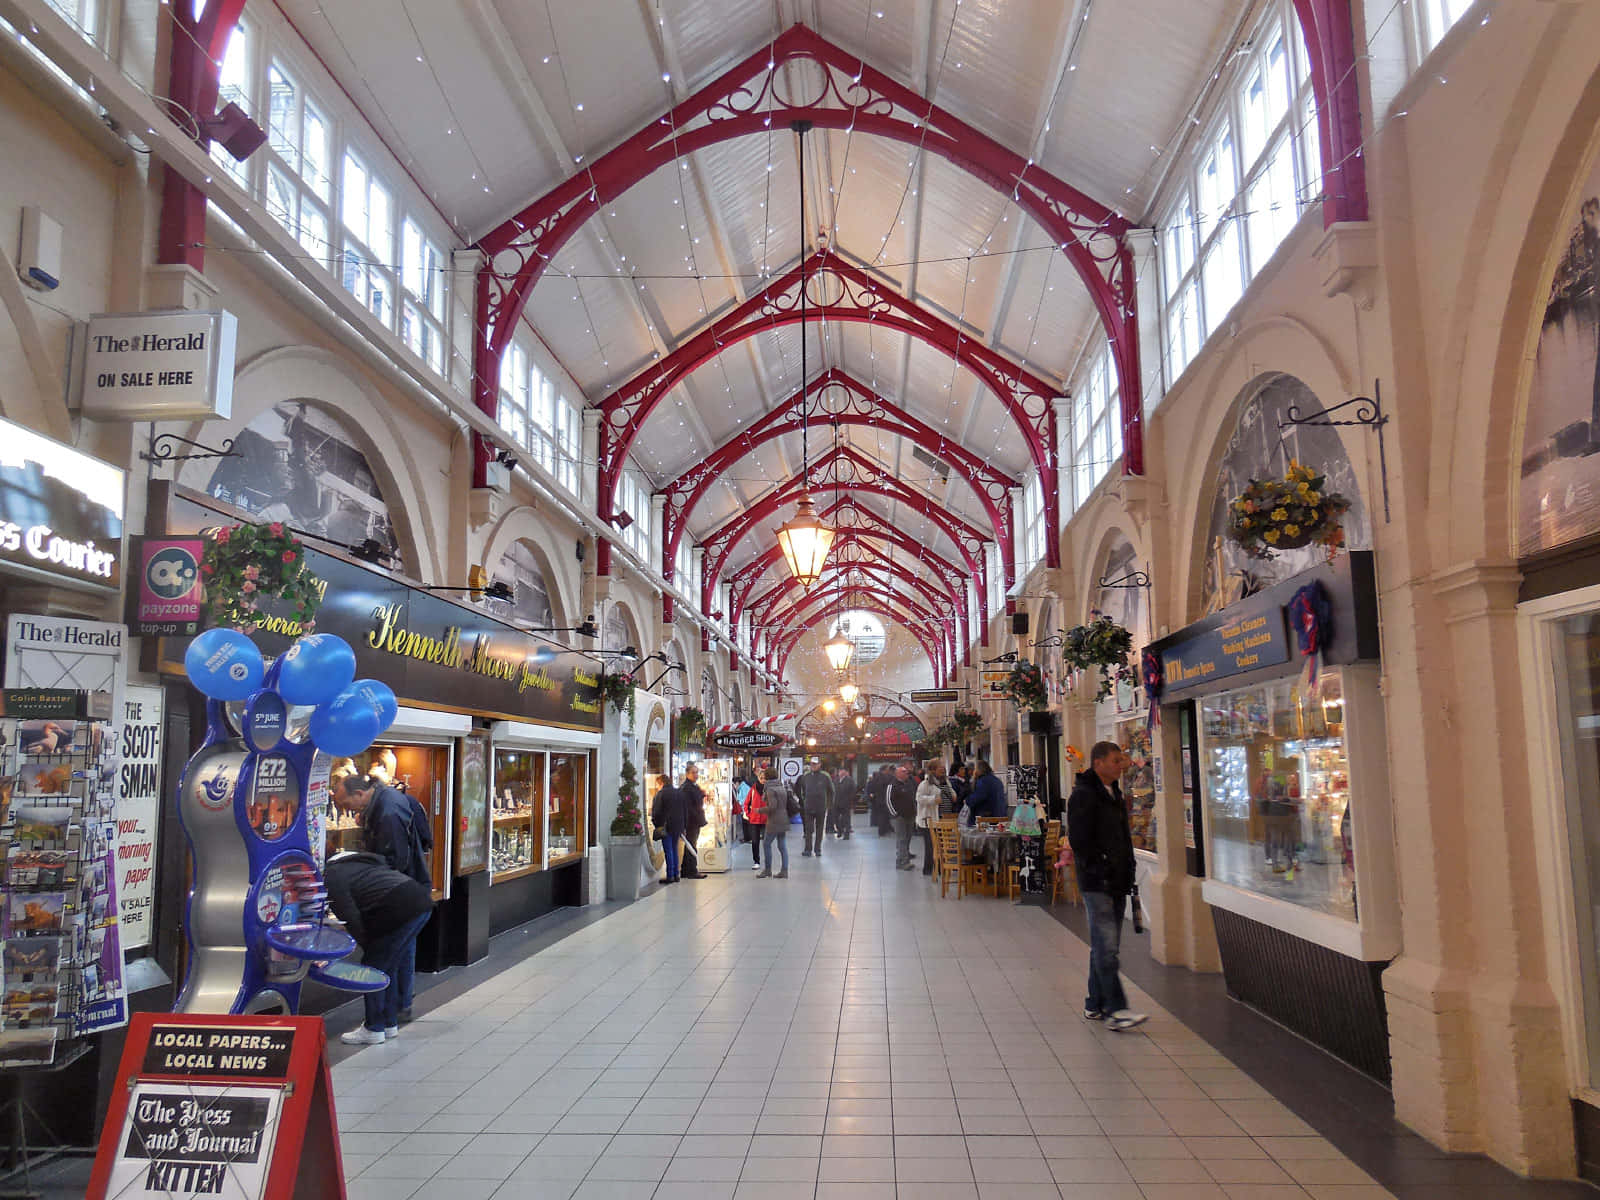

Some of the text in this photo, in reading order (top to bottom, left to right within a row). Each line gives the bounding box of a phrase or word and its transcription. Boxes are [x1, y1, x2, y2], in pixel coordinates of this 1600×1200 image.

[94, 333, 205, 352] The Herald
[98, 371, 193, 388] ON SALE HERE
[26, 525, 116, 578] Courier
[142, 602, 198, 617] payzone
[16, 622, 121, 647] The Herald
[141, 623, 177, 634] top-up
[369, 602, 462, 669] Kenneth
[10, 694, 72, 702] Colin Baxter
[125, 702, 143, 721] THE
[123, 725, 159, 759] SCOT-
[755, 734, 776, 743] SHOP
[258, 758, 287, 777] £72
[120, 764, 158, 799] SMAN
[118, 842, 152, 862] morning
[123, 867, 152, 890] paper
[129, 895, 151, 910] SALE
[155, 1033, 286, 1050] LOCAL PAPERS...
[165, 1054, 267, 1070] LOCAL NEWS
[139, 1099, 233, 1127] The Press
[146, 1128, 261, 1155] and Journal
[144, 1161, 228, 1194] KITTEN
